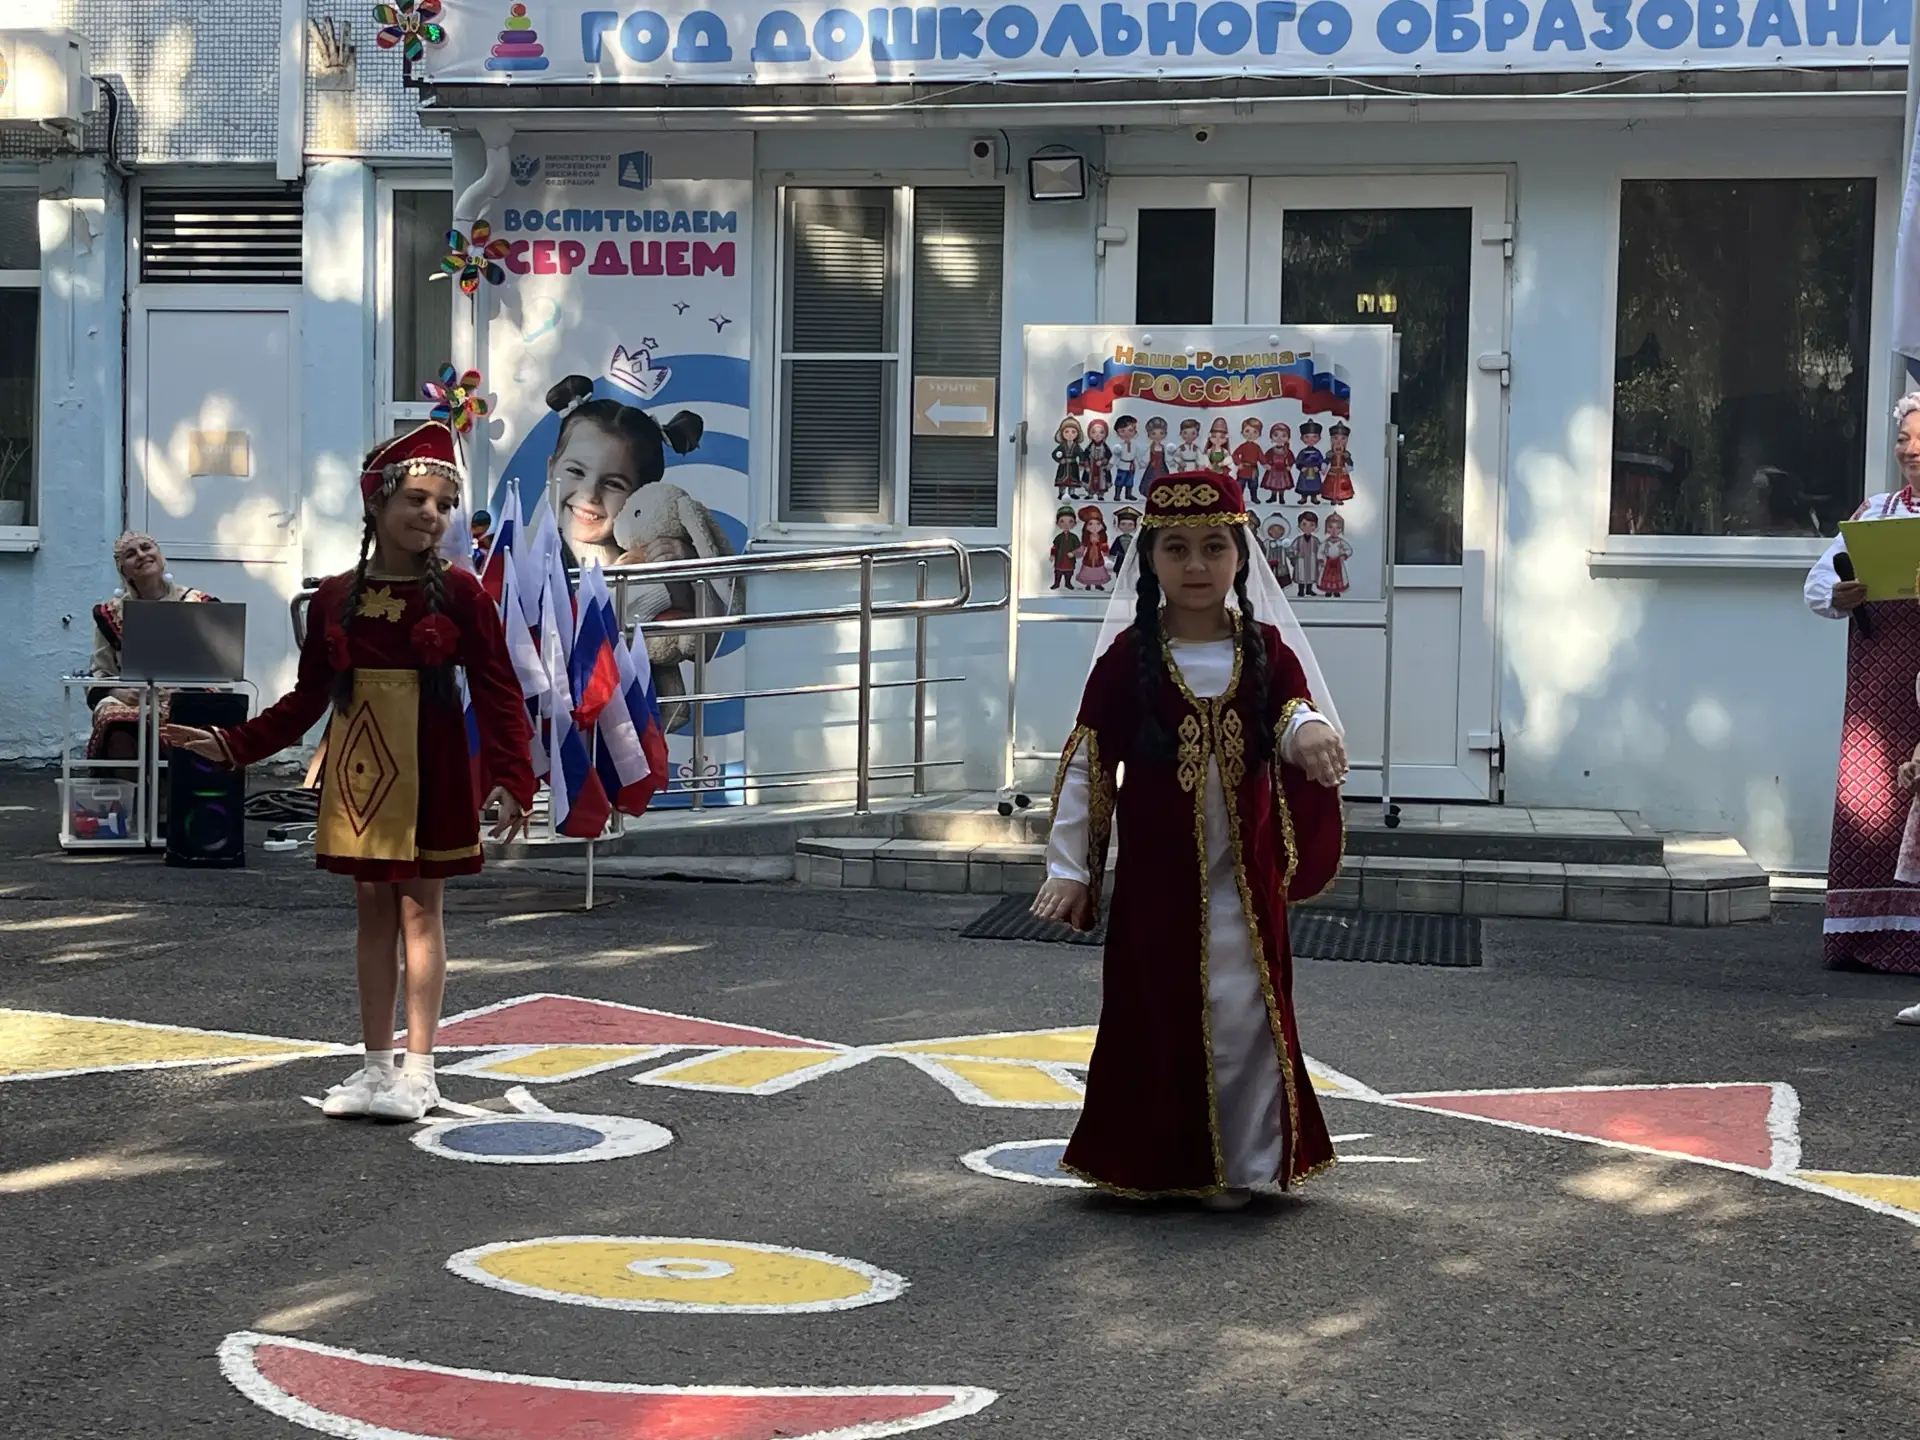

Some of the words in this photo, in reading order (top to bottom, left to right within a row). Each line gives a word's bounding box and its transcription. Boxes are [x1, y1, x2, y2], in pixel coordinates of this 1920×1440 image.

[581, 10, 732, 63] ГОД
[751, 0, 1353, 62] ДОШКОЛЬНОГО
[545, 162, 608, 170] ПРОСВЕЩЕНИЯ
[504, 209, 737, 233] ВОСПИТЫВАЕМ
[504, 240, 736, 277] СЕРДЦЕМ
[1114, 345, 1188, 369] Наша
[1129, 371, 1284, 402] РОССИЯ
